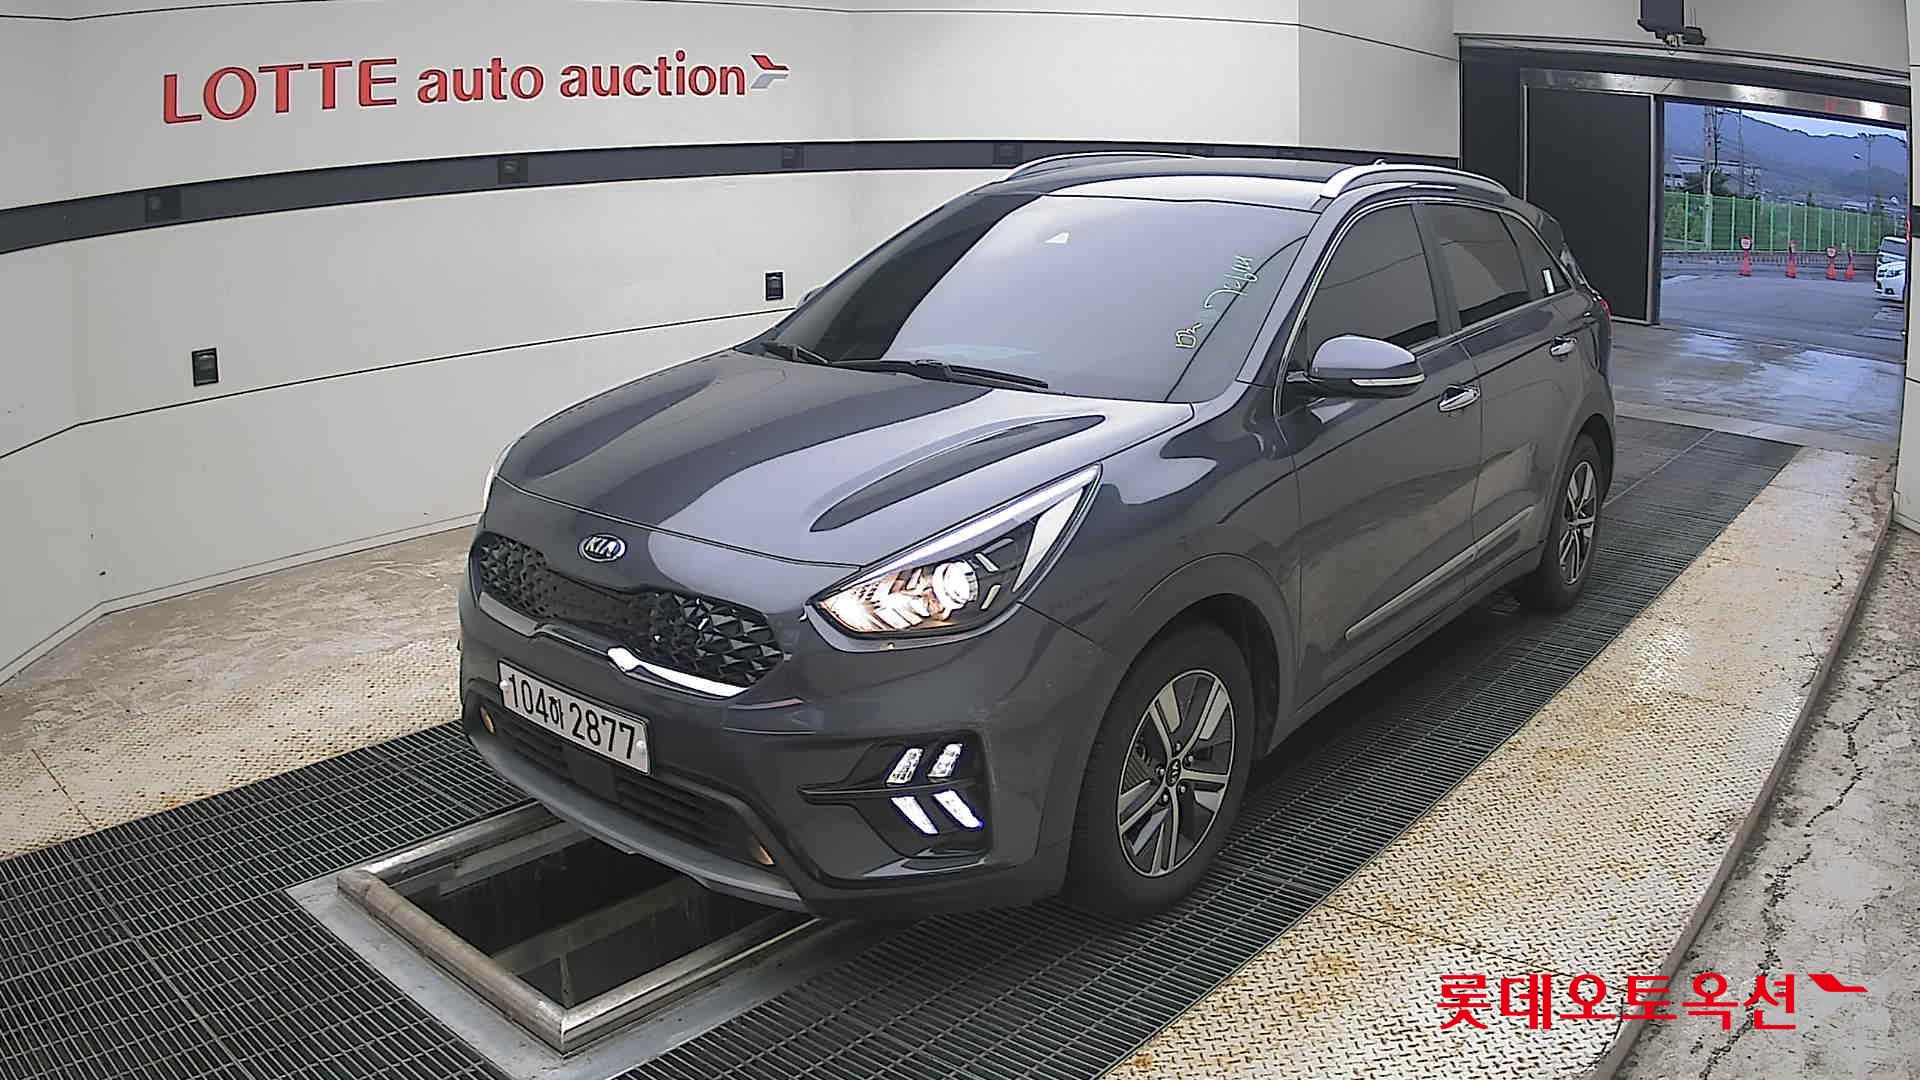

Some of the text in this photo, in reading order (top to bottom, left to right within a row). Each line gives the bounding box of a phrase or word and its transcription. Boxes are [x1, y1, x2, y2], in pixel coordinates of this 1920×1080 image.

[162, 50, 747, 125] LOTTE auto auction
[585, 536, 618, 558] KIA
[569, 702, 636, 760] 2877
